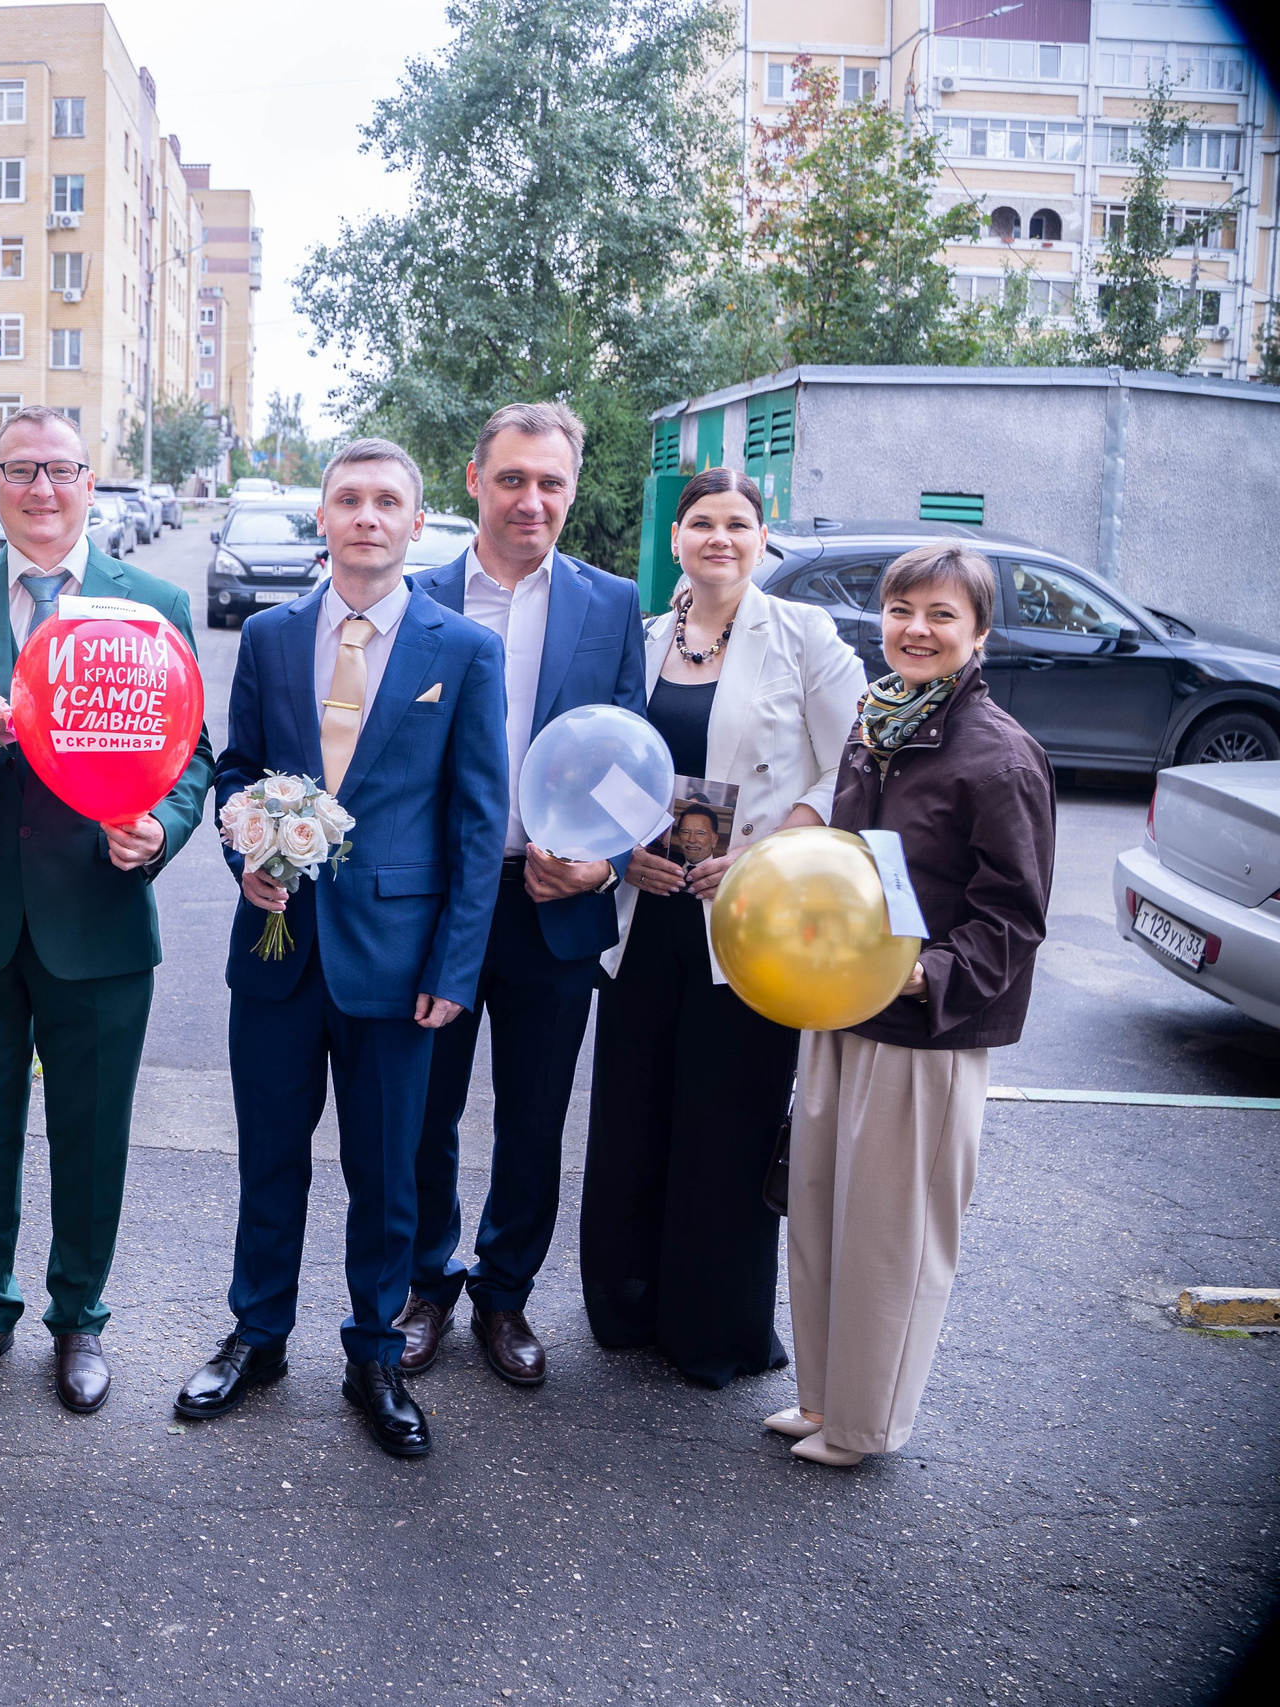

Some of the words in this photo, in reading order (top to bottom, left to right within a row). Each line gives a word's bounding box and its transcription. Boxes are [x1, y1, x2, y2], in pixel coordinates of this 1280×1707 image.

[48, 634, 75, 684] И
[82, 637, 169, 668] УМНАЯ
[84, 667, 167, 690] КРАСИВАЯ
[70, 685, 166, 716] САМОЕ
[66, 710, 167, 733] ГЛАВНОЕ
[1187, 933, 1202, 955] 33
